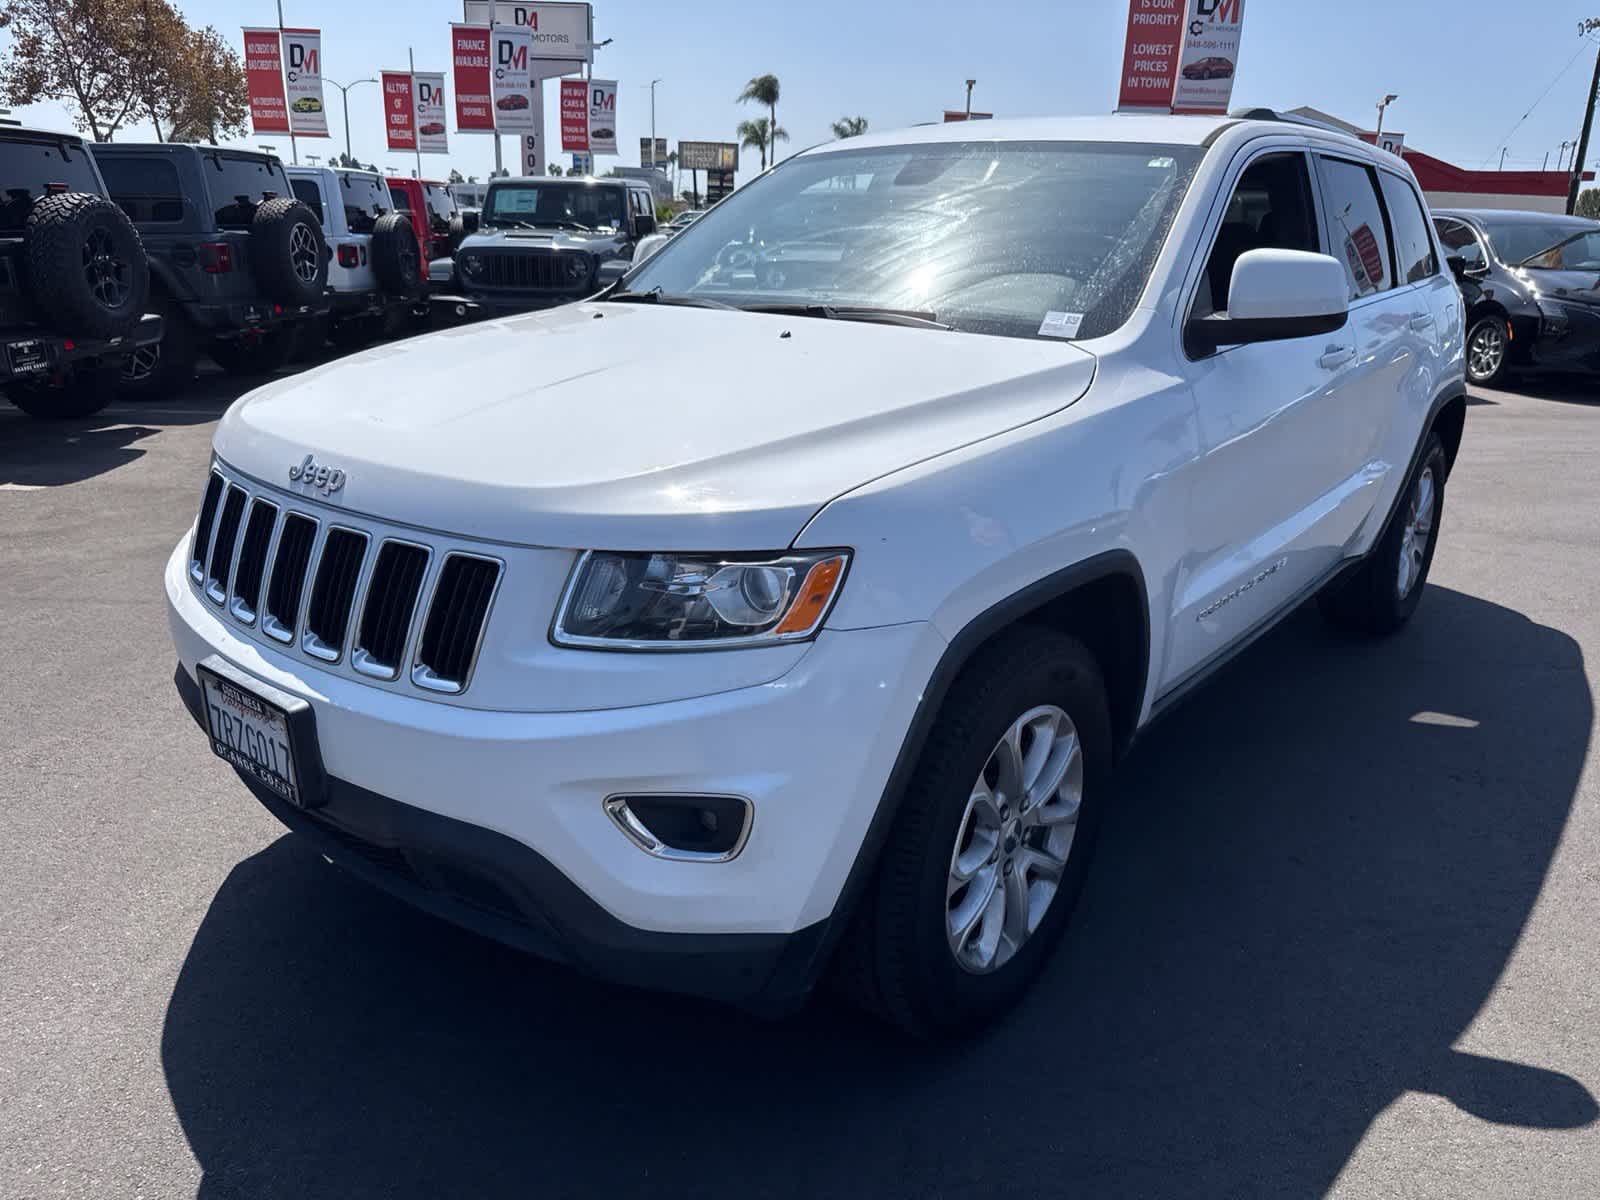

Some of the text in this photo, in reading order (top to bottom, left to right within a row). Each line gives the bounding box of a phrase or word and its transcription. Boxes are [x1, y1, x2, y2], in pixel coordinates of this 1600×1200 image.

[1141, 0, 1175, 9] IS OUR
[1133, 13, 1180, 25] PRIORITY
[457, 39, 486, 51] FINANCE
[531, 34, 569, 44] MOTORS
[1132, 43, 1174, 56] LOWEST
[455, 56, 489, 68] AVAILABLE
[1133, 60, 1169, 73] PRICES
[1127, 77, 1171, 89] IN TOWN
[289, 454, 346, 497] Jeep
[241, 695, 262, 713] MESA
